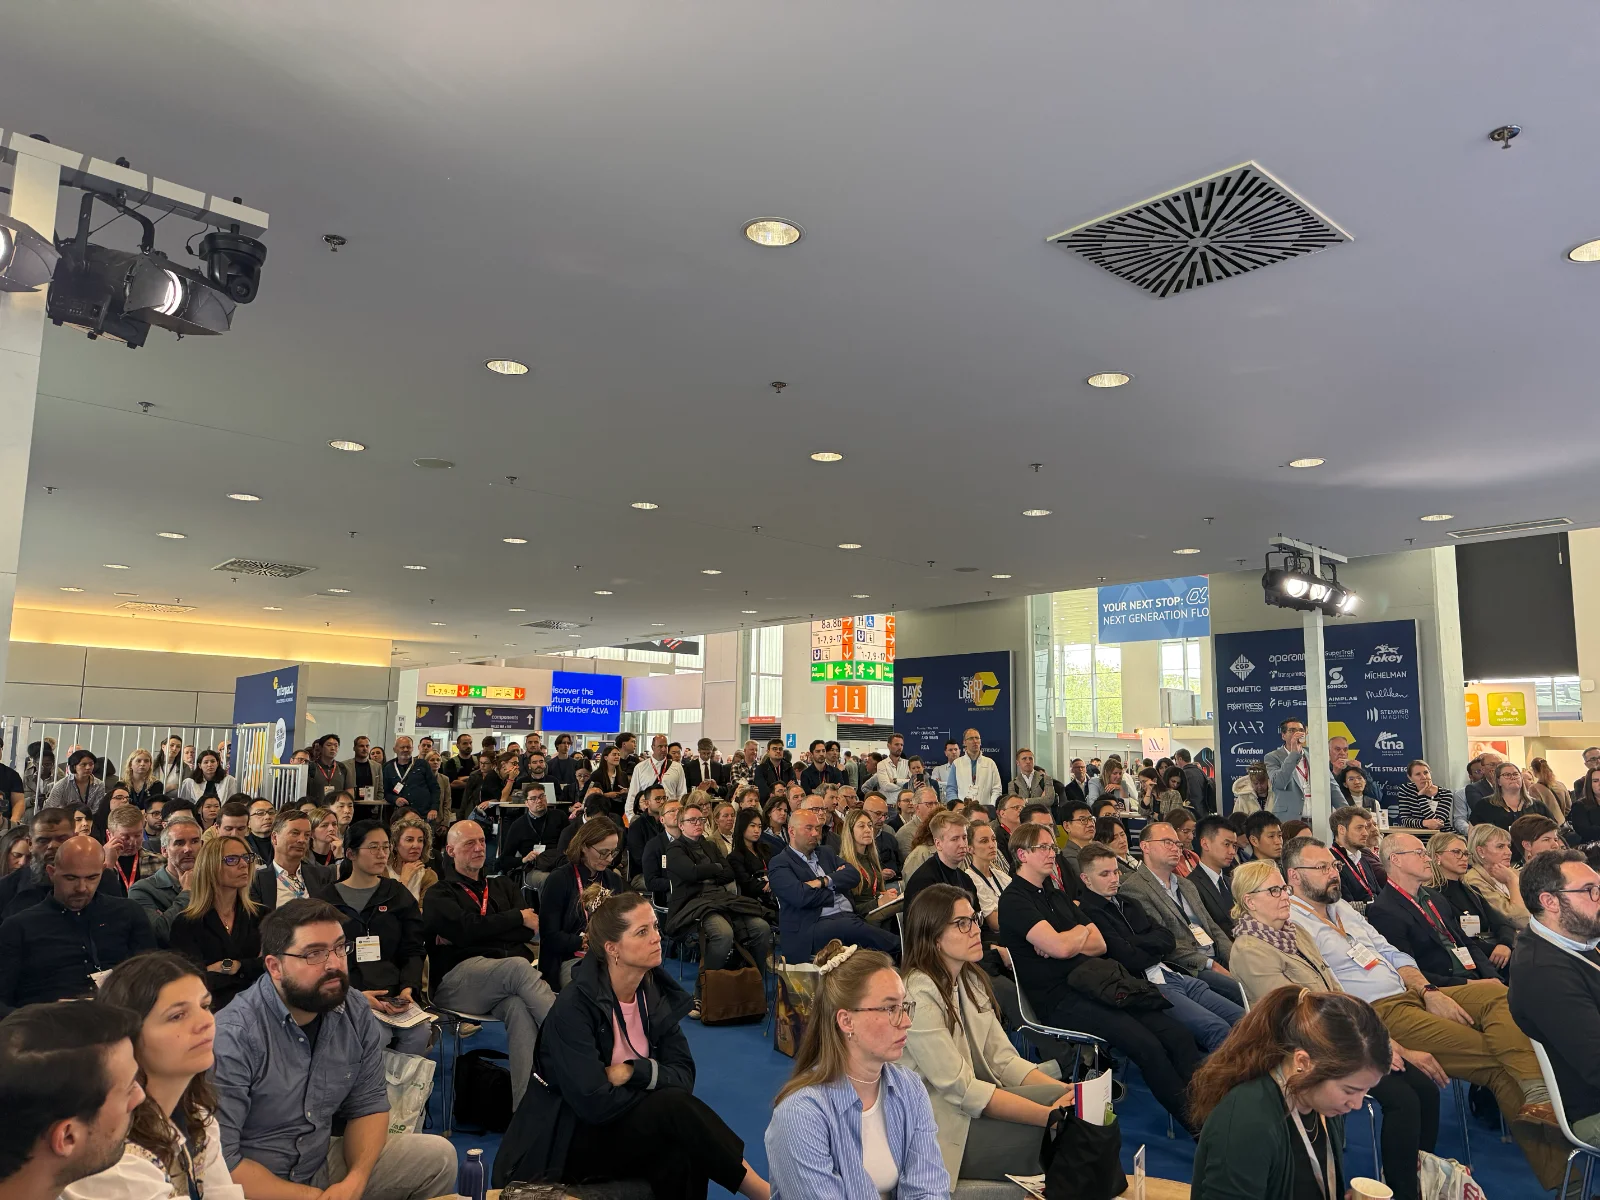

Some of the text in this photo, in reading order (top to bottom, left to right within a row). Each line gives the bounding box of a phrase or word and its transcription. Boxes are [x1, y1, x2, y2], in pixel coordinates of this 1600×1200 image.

[1103, 596, 1184, 612] YOUR NEXT STOP:
[1104, 608, 1210, 626] NEXT GENERATION FLO
[1366, 654, 1404, 664] jokey
[1364, 670, 1406, 680] MICHELMAN
[582, 686, 594, 694] the
[902, 686, 922, 698] DAYS
[1226, 686, 1262, 694] BIOMETIC
[1366, 687, 1408, 700] Milliken
[582, 697, 619, 706] inspection
[902, 698, 922, 708] TOPICS
[1278, 700, 1291, 708] Fuji
[564, 706, 588, 714] Körber
[1228, 722, 1264, 734] XAAR
[1381, 740, 1404, 750] tna
